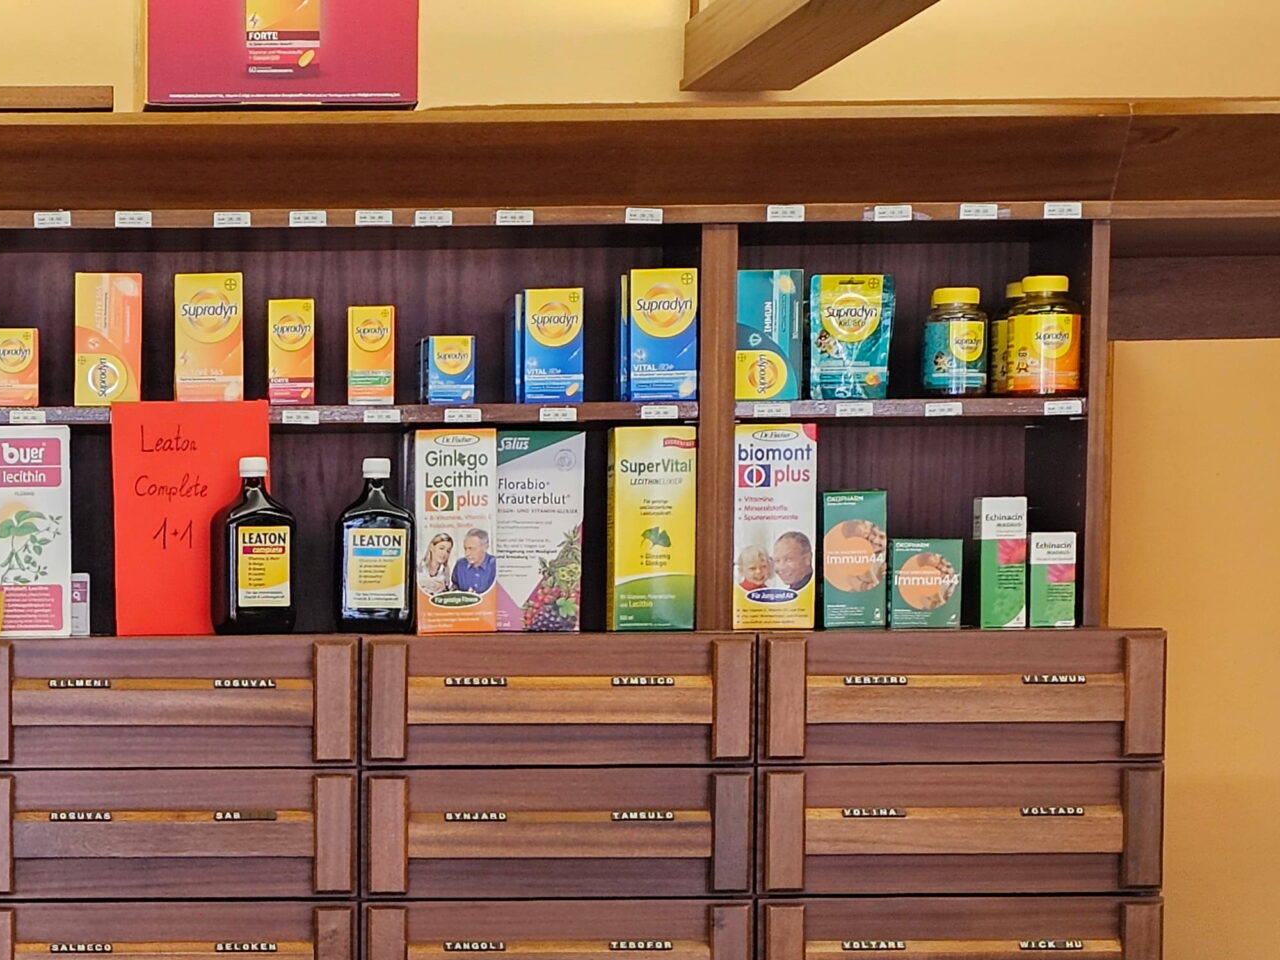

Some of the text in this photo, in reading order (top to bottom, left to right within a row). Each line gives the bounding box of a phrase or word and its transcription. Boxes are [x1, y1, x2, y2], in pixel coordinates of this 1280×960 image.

[182, 303, 238, 318] Supradyn
[636, 298, 692, 312] Supradyn
[825, 305, 878, 319] Supradyn
[531, 313, 578, 325] Supradyn
[272, 323, 310, 335] Supradyn
[758, 354, 766, 394] Supradyn
[140, 425, 197, 453] Leaton
[498, 437, 530, 451] Salus
[2, 443, 44, 464] buer
[738, 444, 811, 461] biomont
[425, 450, 488, 470] Ginkgo
[621, 459, 692, 476] SuperVital
[3, 471, 46, 483] lecithin
[425, 471, 488, 488] Lecithin
[775, 465, 810, 487] plus
[134, 473, 208, 498] Complete
[457, 491, 488, 510] plus
[153, 519, 193, 549] 1+1
[242, 533, 286, 544] LEATON
[353, 535, 402, 546] LEATON
[827, 555, 884, 564] Immun44
[49, 679, 110, 688] RILMENI
[214, 679, 275, 688] ROSUVAL
[1024, 675, 1086, 684] VITAWUN
[50, 812, 112, 822] ROSUVAS
[215, 812, 241, 821] SAB
[446, 812, 506, 821] SYNJARD
[612, 811, 673, 821] TAMSULO
[844, 808, 897, 817] VOLINA
[1022, 807, 1083, 816] VOLTADO
[51, 943, 111, 953] SALMECO
[216, 942, 276, 952] SELOKEN
[445, 942, 504, 951] TANGOLI
